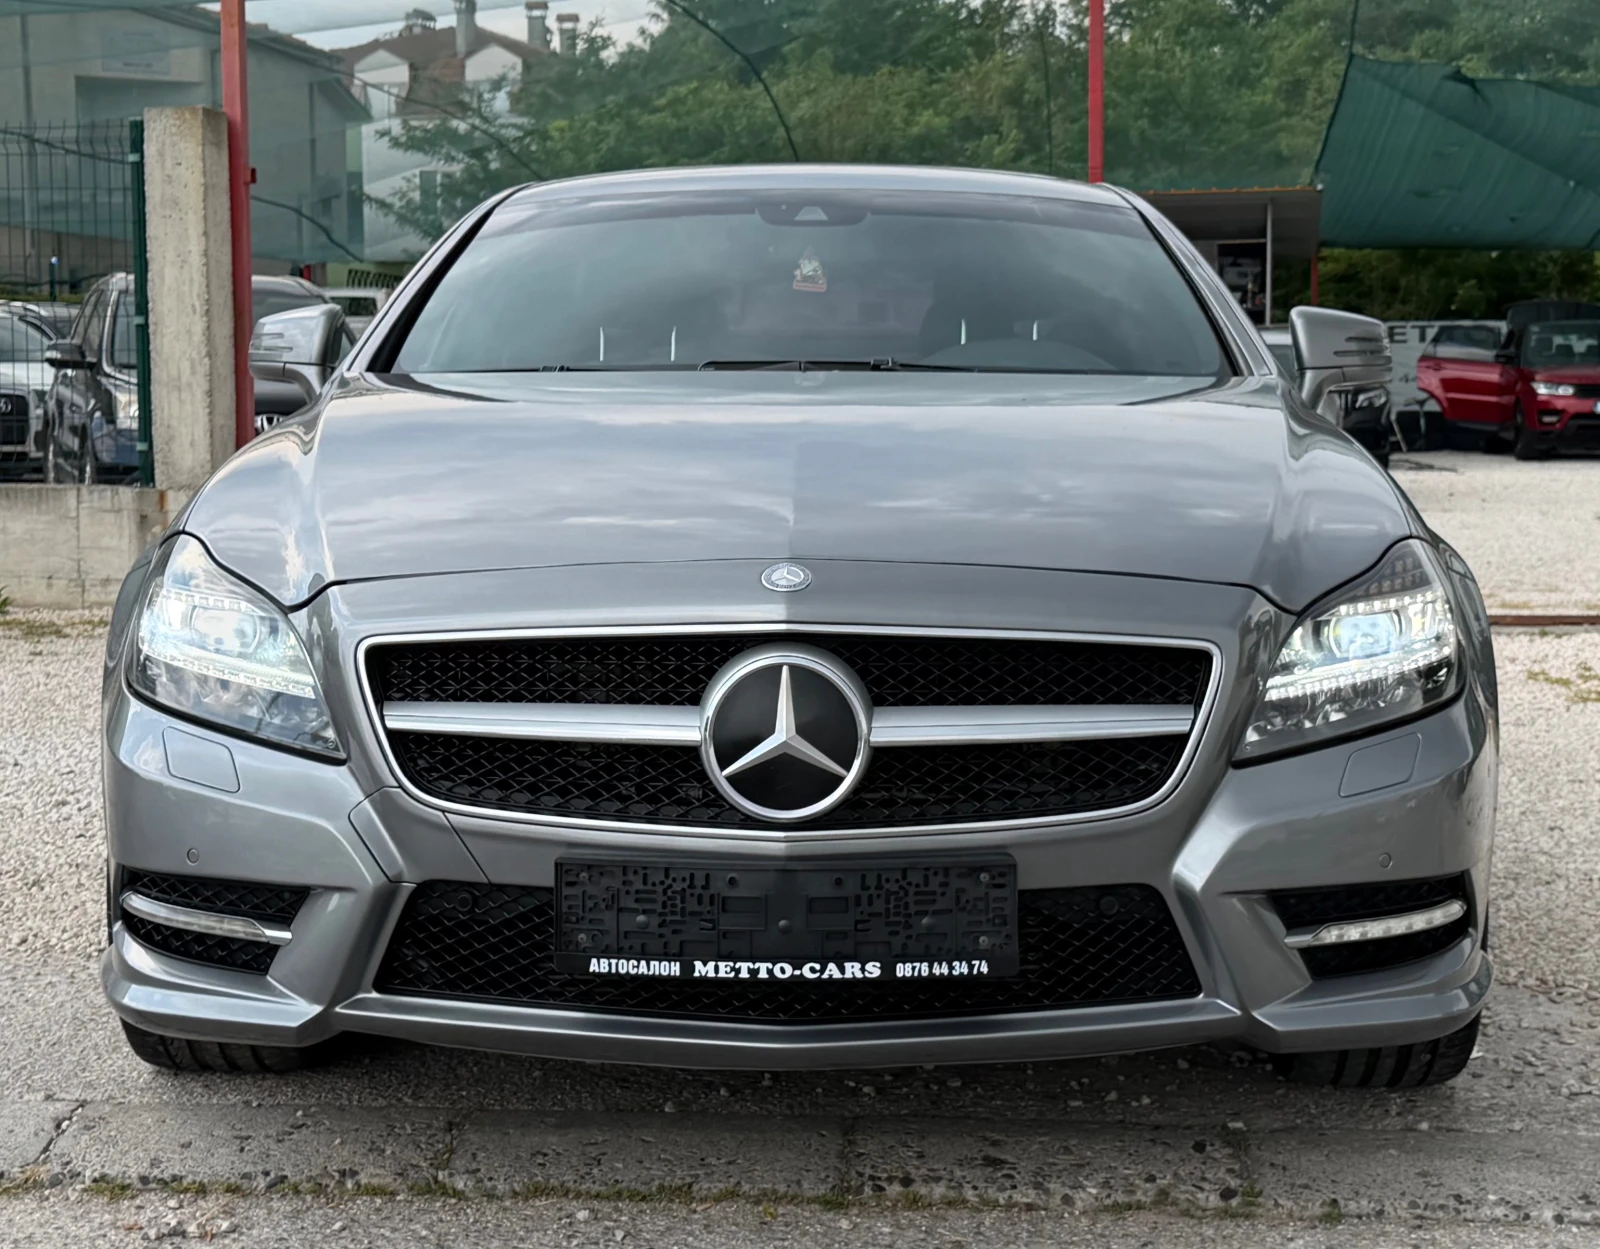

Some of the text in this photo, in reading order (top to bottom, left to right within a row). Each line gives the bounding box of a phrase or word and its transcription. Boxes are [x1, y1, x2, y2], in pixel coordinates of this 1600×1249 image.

[589, 957, 989, 979] АВТОСАЛОН METTO-CARS 0876 44 34 74
